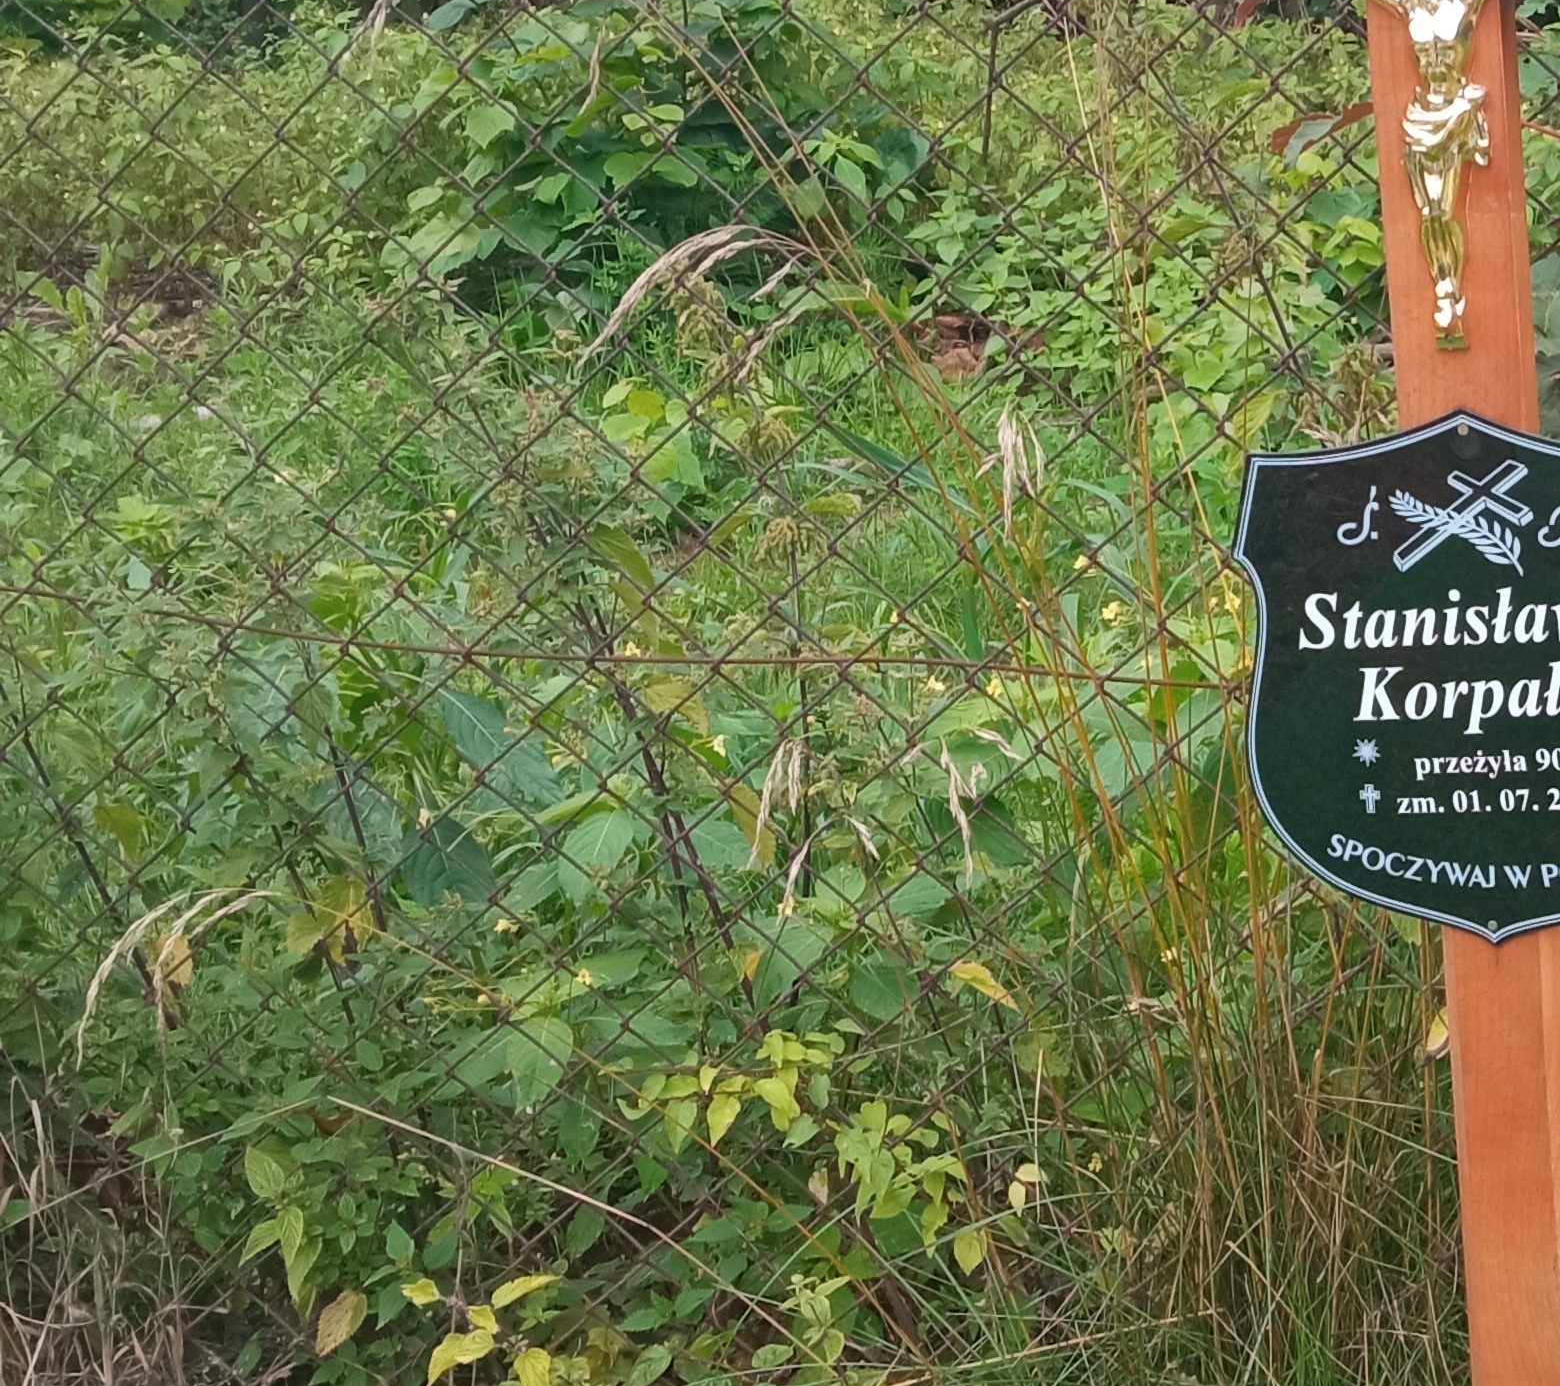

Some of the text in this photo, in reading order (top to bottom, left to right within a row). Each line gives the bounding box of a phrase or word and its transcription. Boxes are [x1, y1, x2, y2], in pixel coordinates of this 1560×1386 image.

[1413, 749, 1528, 781] przeżyła
[1396, 796, 1445, 815] zm.
[1452, 789, 1492, 813] 01.
[1499, 788, 1539, 812] 07.
[1327, 834, 1497, 889] SPOCZYWAJ
[1503, 864, 1532, 889] W
